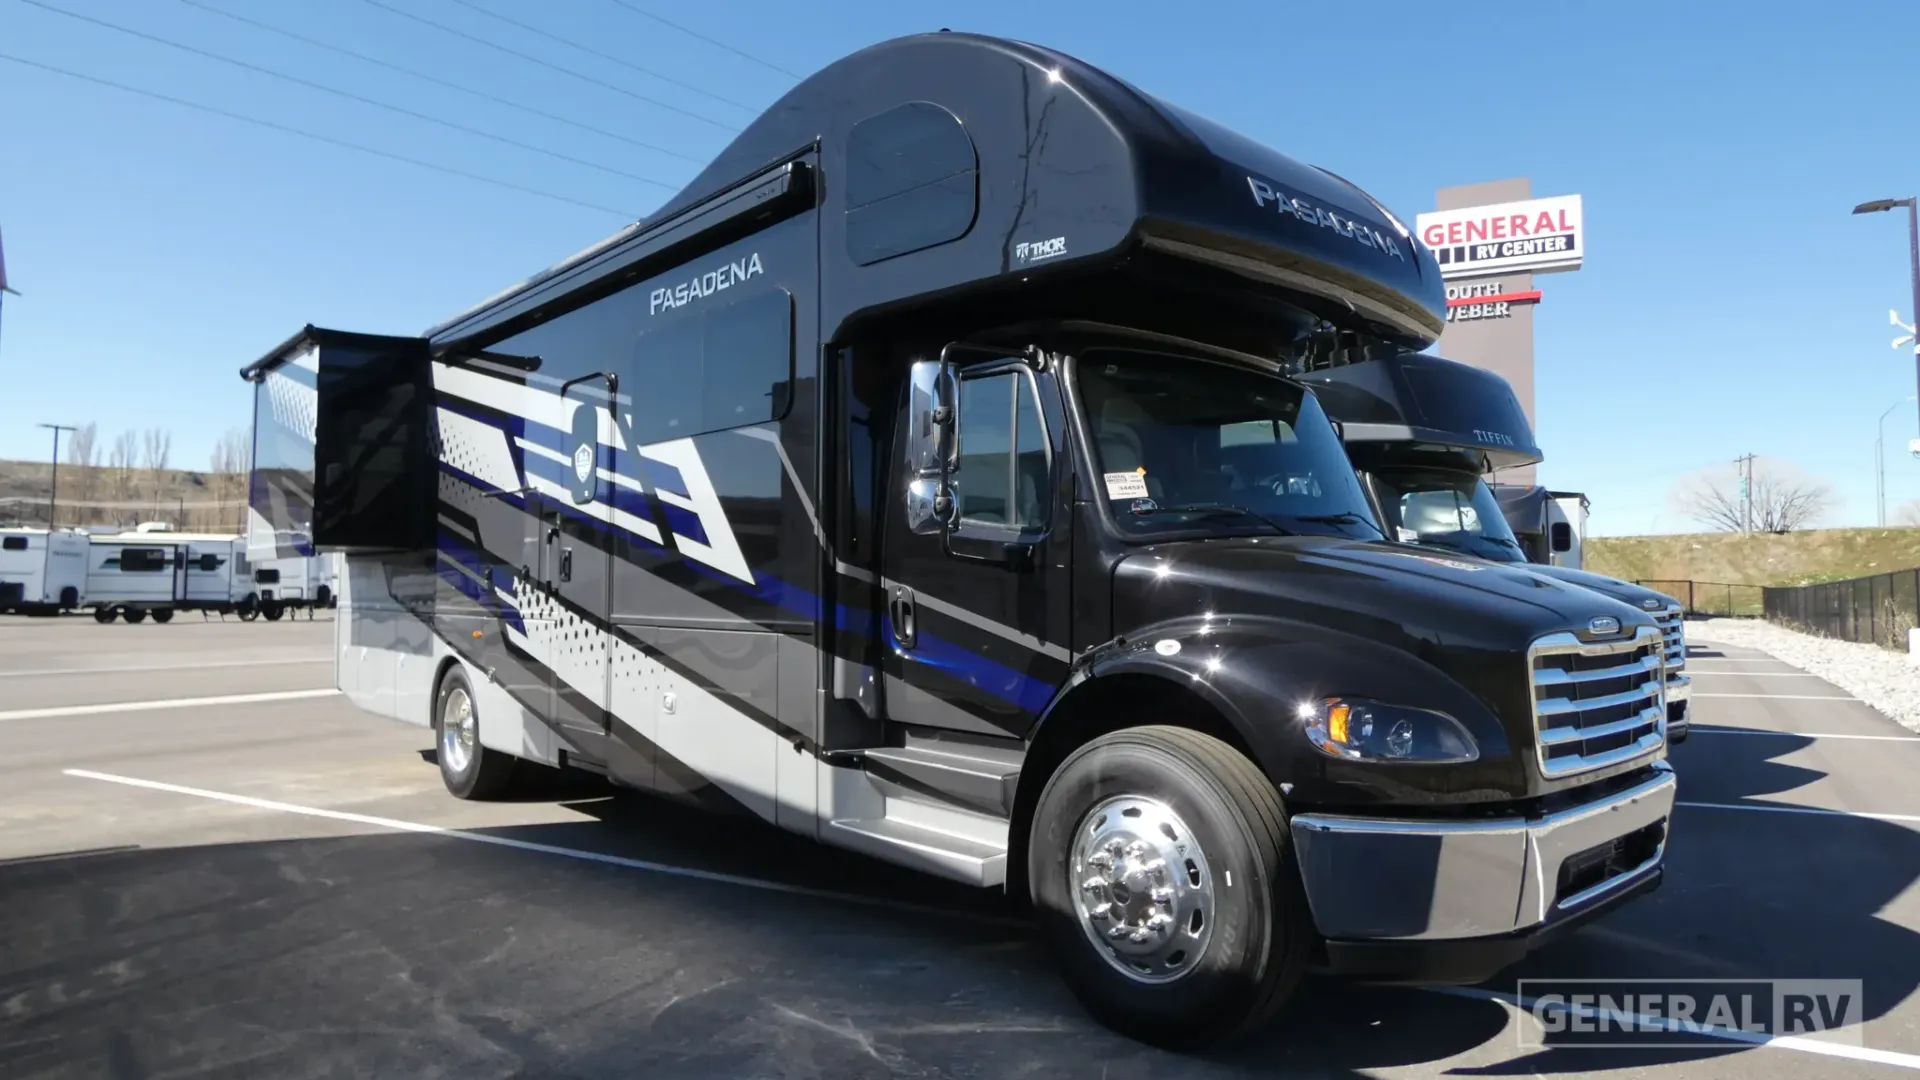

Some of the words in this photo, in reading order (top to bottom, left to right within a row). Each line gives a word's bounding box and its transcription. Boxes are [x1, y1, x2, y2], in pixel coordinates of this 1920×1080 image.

[1247, 177, 1405, 262] PASADENA
[1424, 209, 1575, 246] GENERAL
[1030, 236, 1066, 256] THOR
[1476, 244, 1500, 259] RV
[1502, 236, 1568, 257] CENTER
[650, 252, 764, 316] PASADENA
[1446, 282, 1501, 300] OUTH
[1473, 430, 1513, 446] TIFFIN
